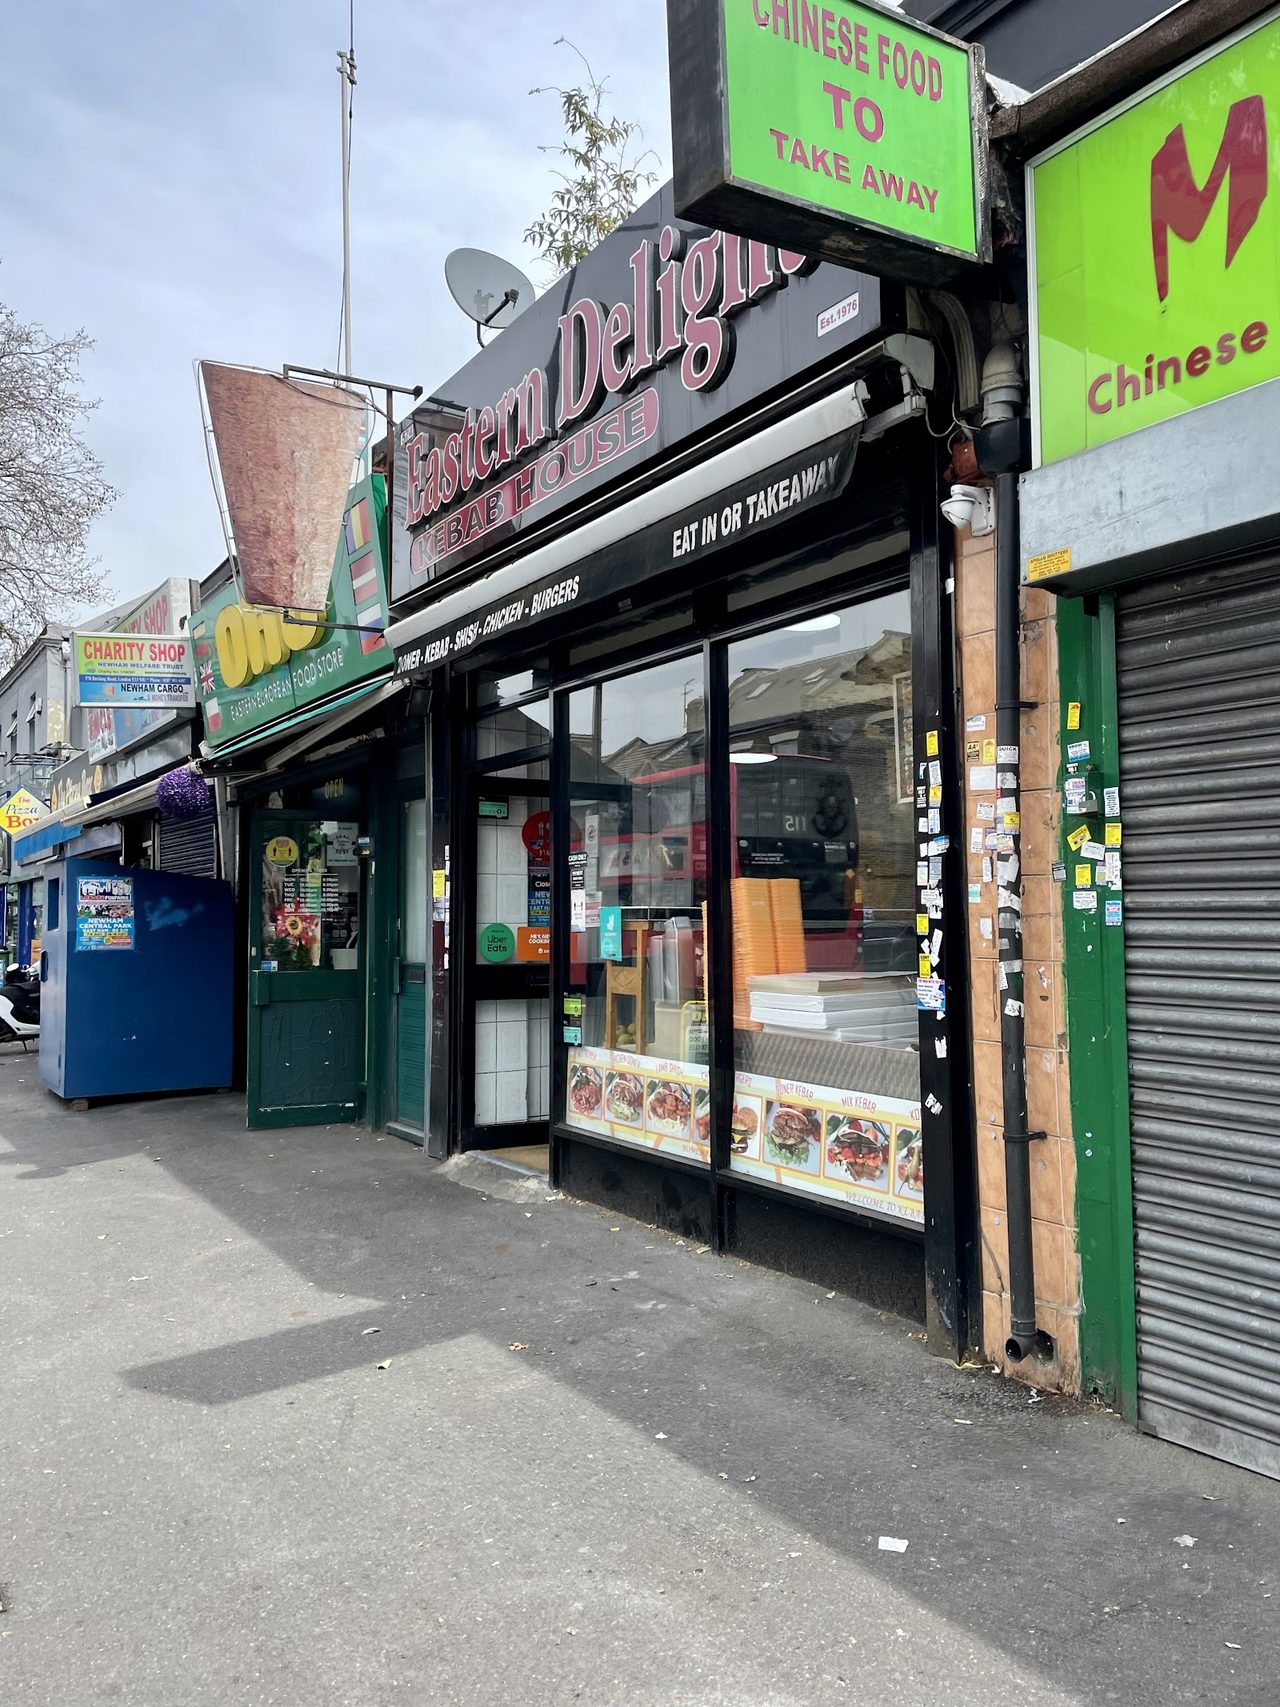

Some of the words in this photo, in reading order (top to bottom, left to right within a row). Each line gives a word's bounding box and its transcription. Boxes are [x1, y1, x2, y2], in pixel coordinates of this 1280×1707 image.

[752, 0, 871, 74] CHINESE
[879, 33, 944, 102] FOOD
[822, 79, 885, 142] TO
[769, 127, 851, 184] TAKE
[861, 164, 940, 214] AWAY
[1150, 94, 1268, 303] M
[819, 298, 859, 332] Est.1976
[1086, 319, 1269, 415] Chinese
[404, 366, 547, 532] Eastern
[416, 490, 505, 568] KEBAB
[515, 398, 648, 511] HOUSE
[673, 521, 699, 558] EAT
[701, 512, 718, 546] IN
[721, 501, 742, 537] OR
[746, 452, 841, 524] TAKEAWAY
[1030, 555, 1046, 564] APOLLO
[1046, 549, 1069, 559] SHUTTERS
[144, 594, 168, 635] SHOP
[424, 636, 450, 666] KEBAB
[483, 600, 524, 636] CHICKEN
[530, 575, 580, 617] BURGERS
[83, 640, 145, 661] CHARITY
[149, 643, 186, 662] SHOP
[120, 684, 155, 693] NEWHAM
[157, 684, 184, 693] CARGO
[230, 697, 256, 721] EASTERN
[256, 678, 291, 712] EUROPEAN
[292, 662, 317, 691] FOOD
[317, 647, 344, 678] STORE
[18, 796, 31, 804] The
[324, 777, 344, 799] OPEN
[6, 804, 39, 815] Pizza
[487, 935, 507, 944] Uber
[487, 944, 508, 952] Eats
[795, 1084, 814, 1102] KEBAB
[841, 1097, 854, 1109] MIX
[855, 1097, 877, 1113] KEBAB
[846, 1191, 885, 1209] WELCOME
[886, 1201, 897, 1211] TO
